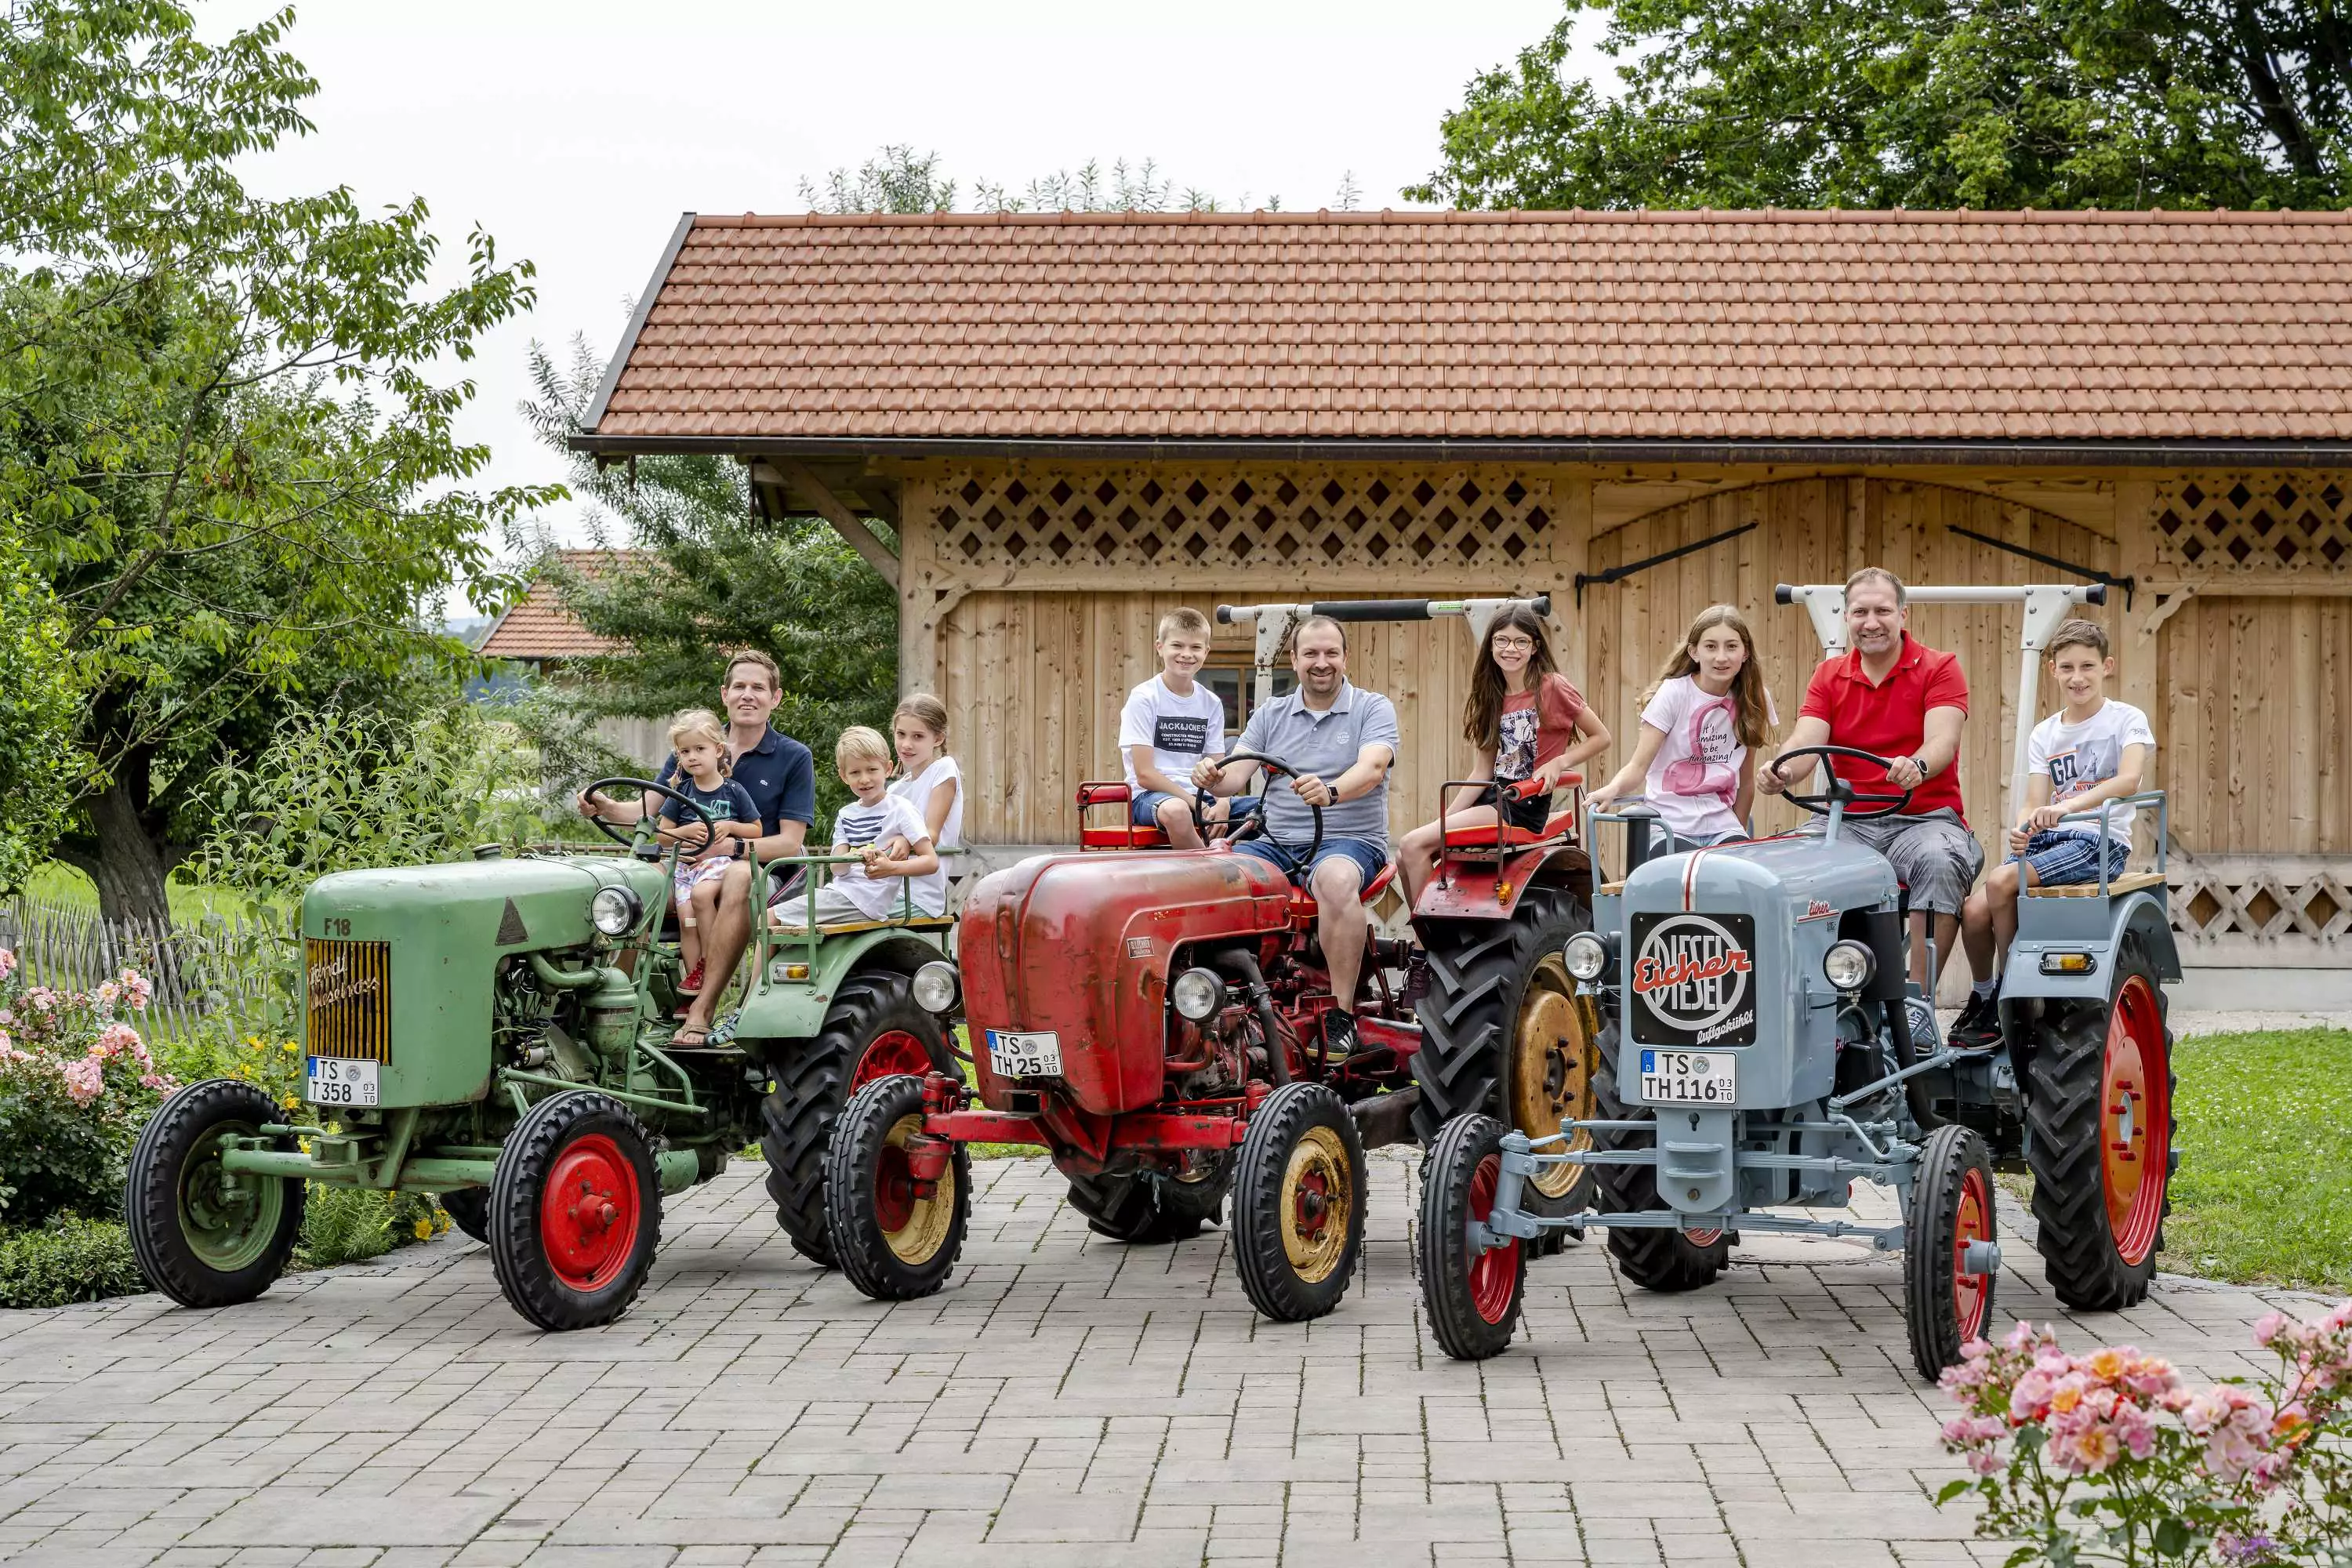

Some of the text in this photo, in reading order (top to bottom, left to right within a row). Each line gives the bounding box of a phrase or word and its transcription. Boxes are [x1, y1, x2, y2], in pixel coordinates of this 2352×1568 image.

[1160, 722, 1207, 731] JACK&JONES
[1703, 724, 1715, 734] It's
[1696, 734, 1727, 744] amazing
[1710, 743, 1719, 753] be
[2049, 754, 2078, 786] GO
[325, 917, 351, 937] F18
[1633, 949, 1752, 994] Eicher
[1653, 934, 1726, 1011] DIESEL
[999, 1035, 1021, 1055] TS
[1044, 1054, 1056, 1062] 03
[1662, 1054, 1689, 1075] TS
[321, 1060, 338, 1080] TS
[1719, 1079, 1732, 1087] 03
[1721, 1092, 1733, 1101] 10
